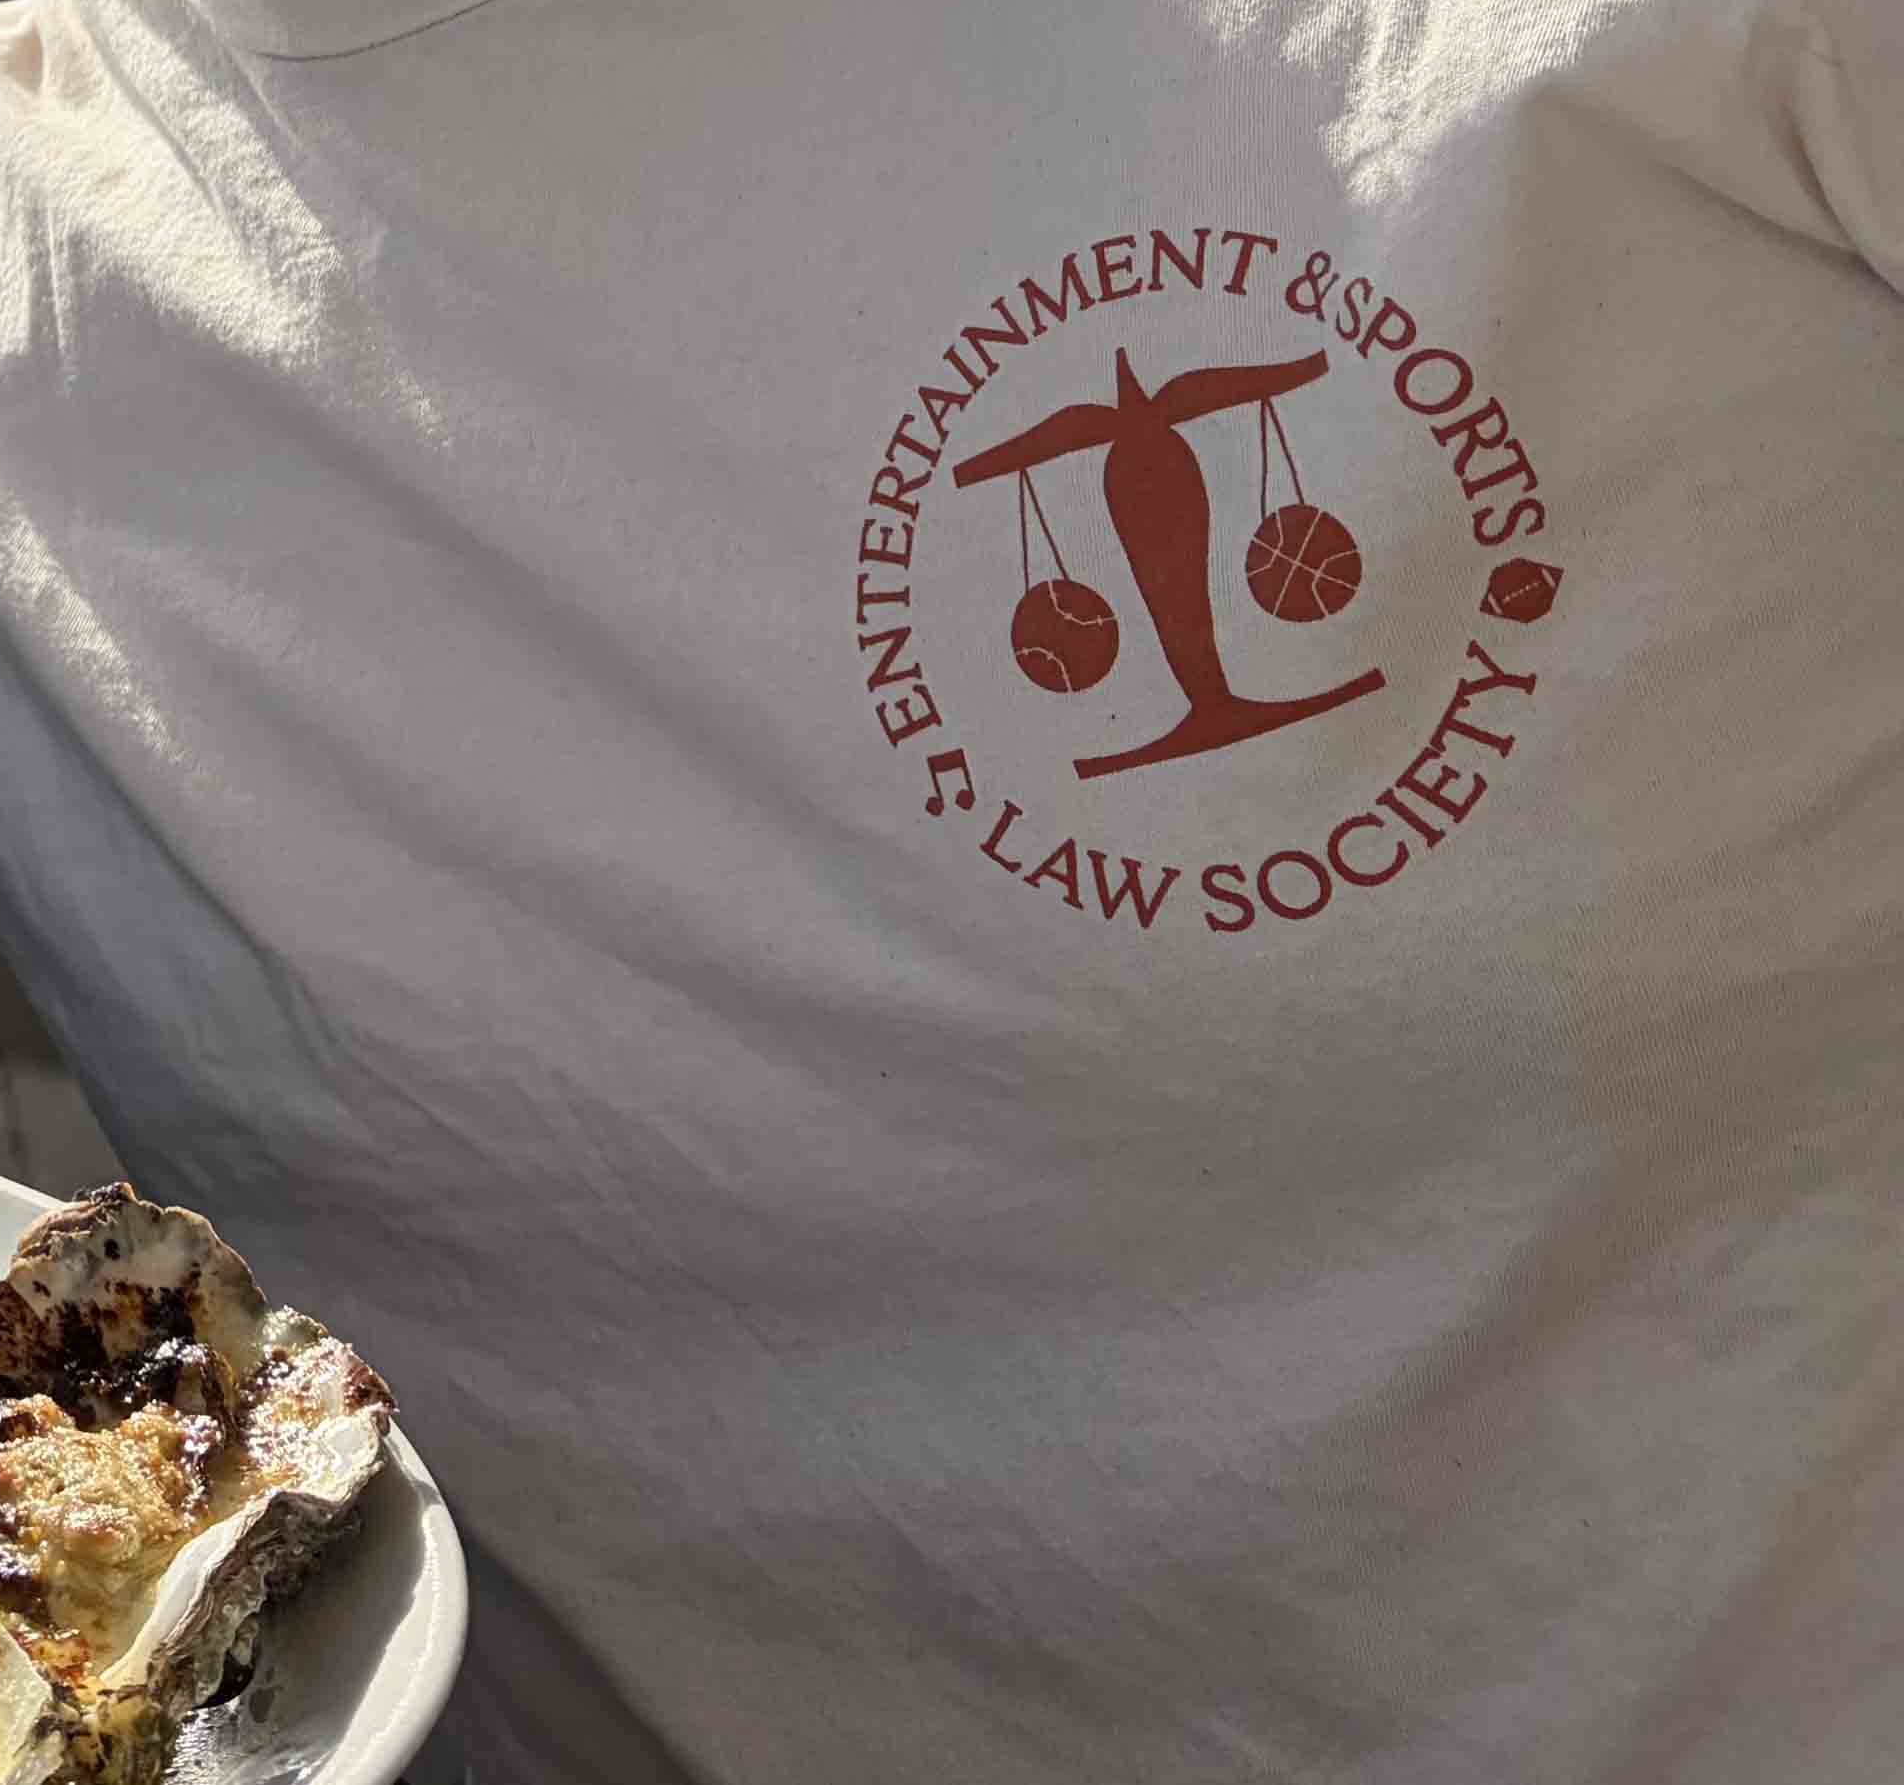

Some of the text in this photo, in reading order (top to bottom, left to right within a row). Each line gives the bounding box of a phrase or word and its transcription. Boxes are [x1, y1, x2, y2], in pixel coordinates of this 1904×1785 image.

[856, 227, 1279, 748] ENTERTAINMENT
[979, 639, 1538, 934] LAW SOCIETY
